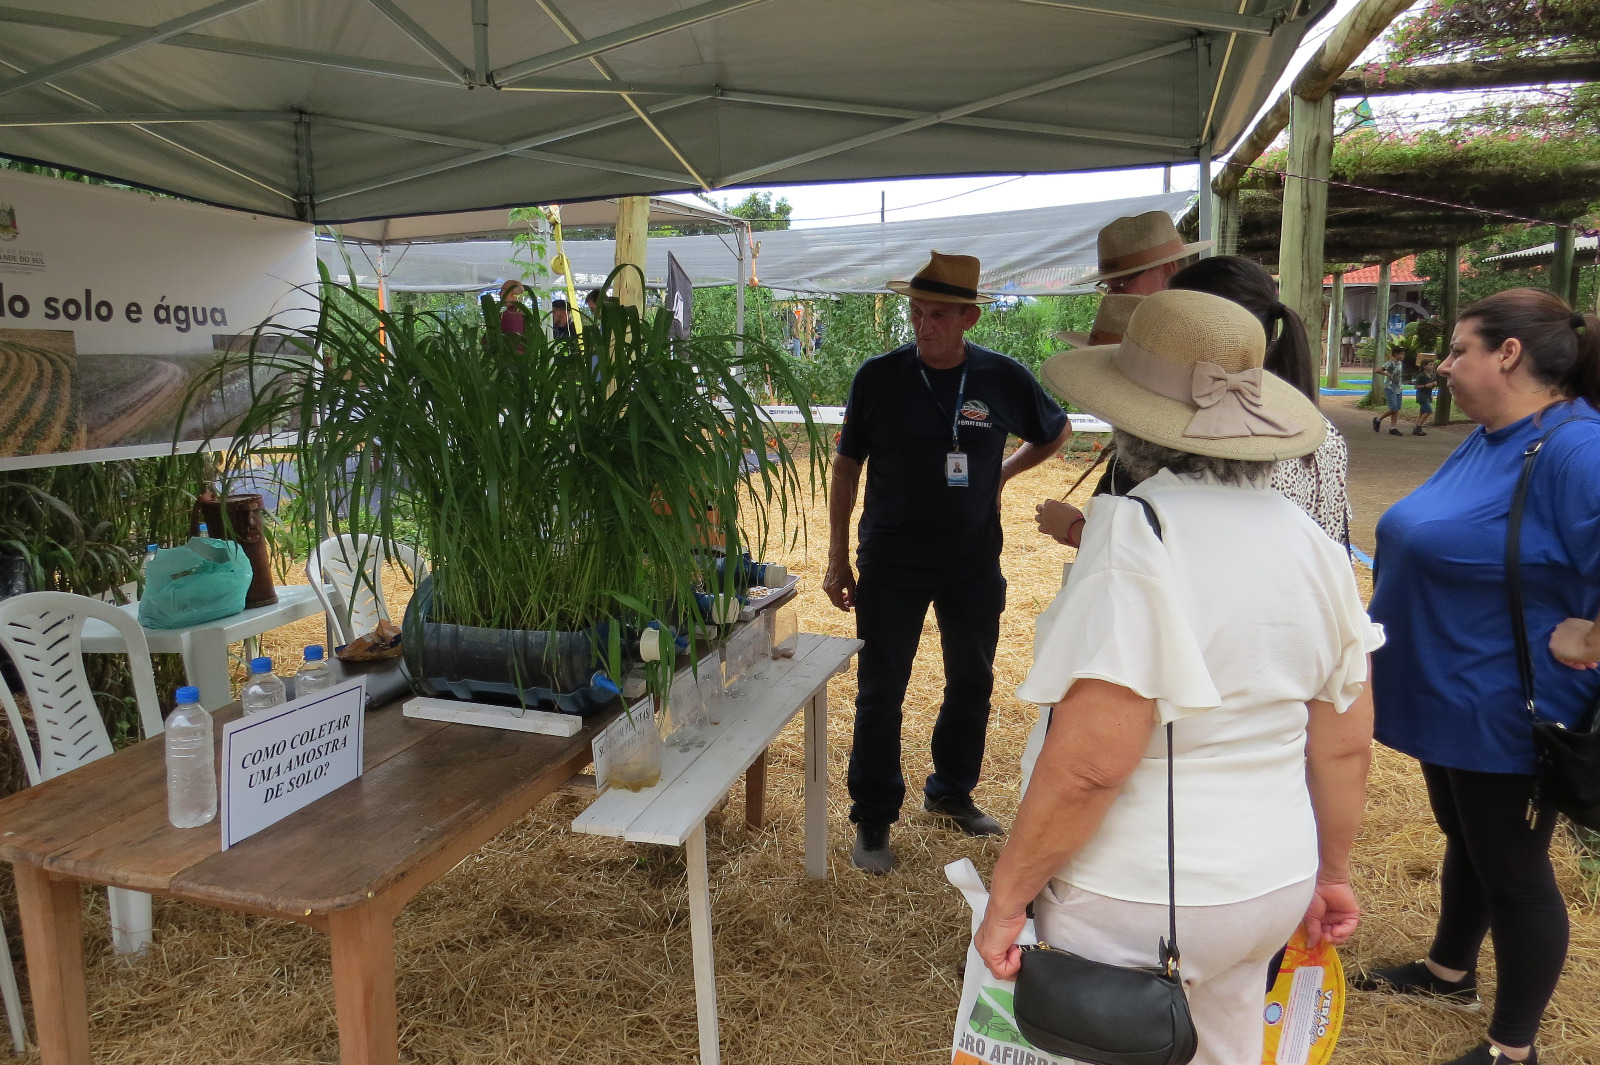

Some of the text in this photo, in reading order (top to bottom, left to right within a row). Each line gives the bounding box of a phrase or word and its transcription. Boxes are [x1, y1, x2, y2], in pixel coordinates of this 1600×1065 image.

[32, 257, 46, 265] SUL
[0, 283, 229, 333] o solo e água
[241, 714, 351, 769] COMO COLETAR
[248, 735, 348, 789] UMA AMOSTRA
[263, 761, 330, 804] DE SOLO?
[1317, 989, 1333, 1037] VERÃO
[989, 1044, 1058, 1065] AFUB
